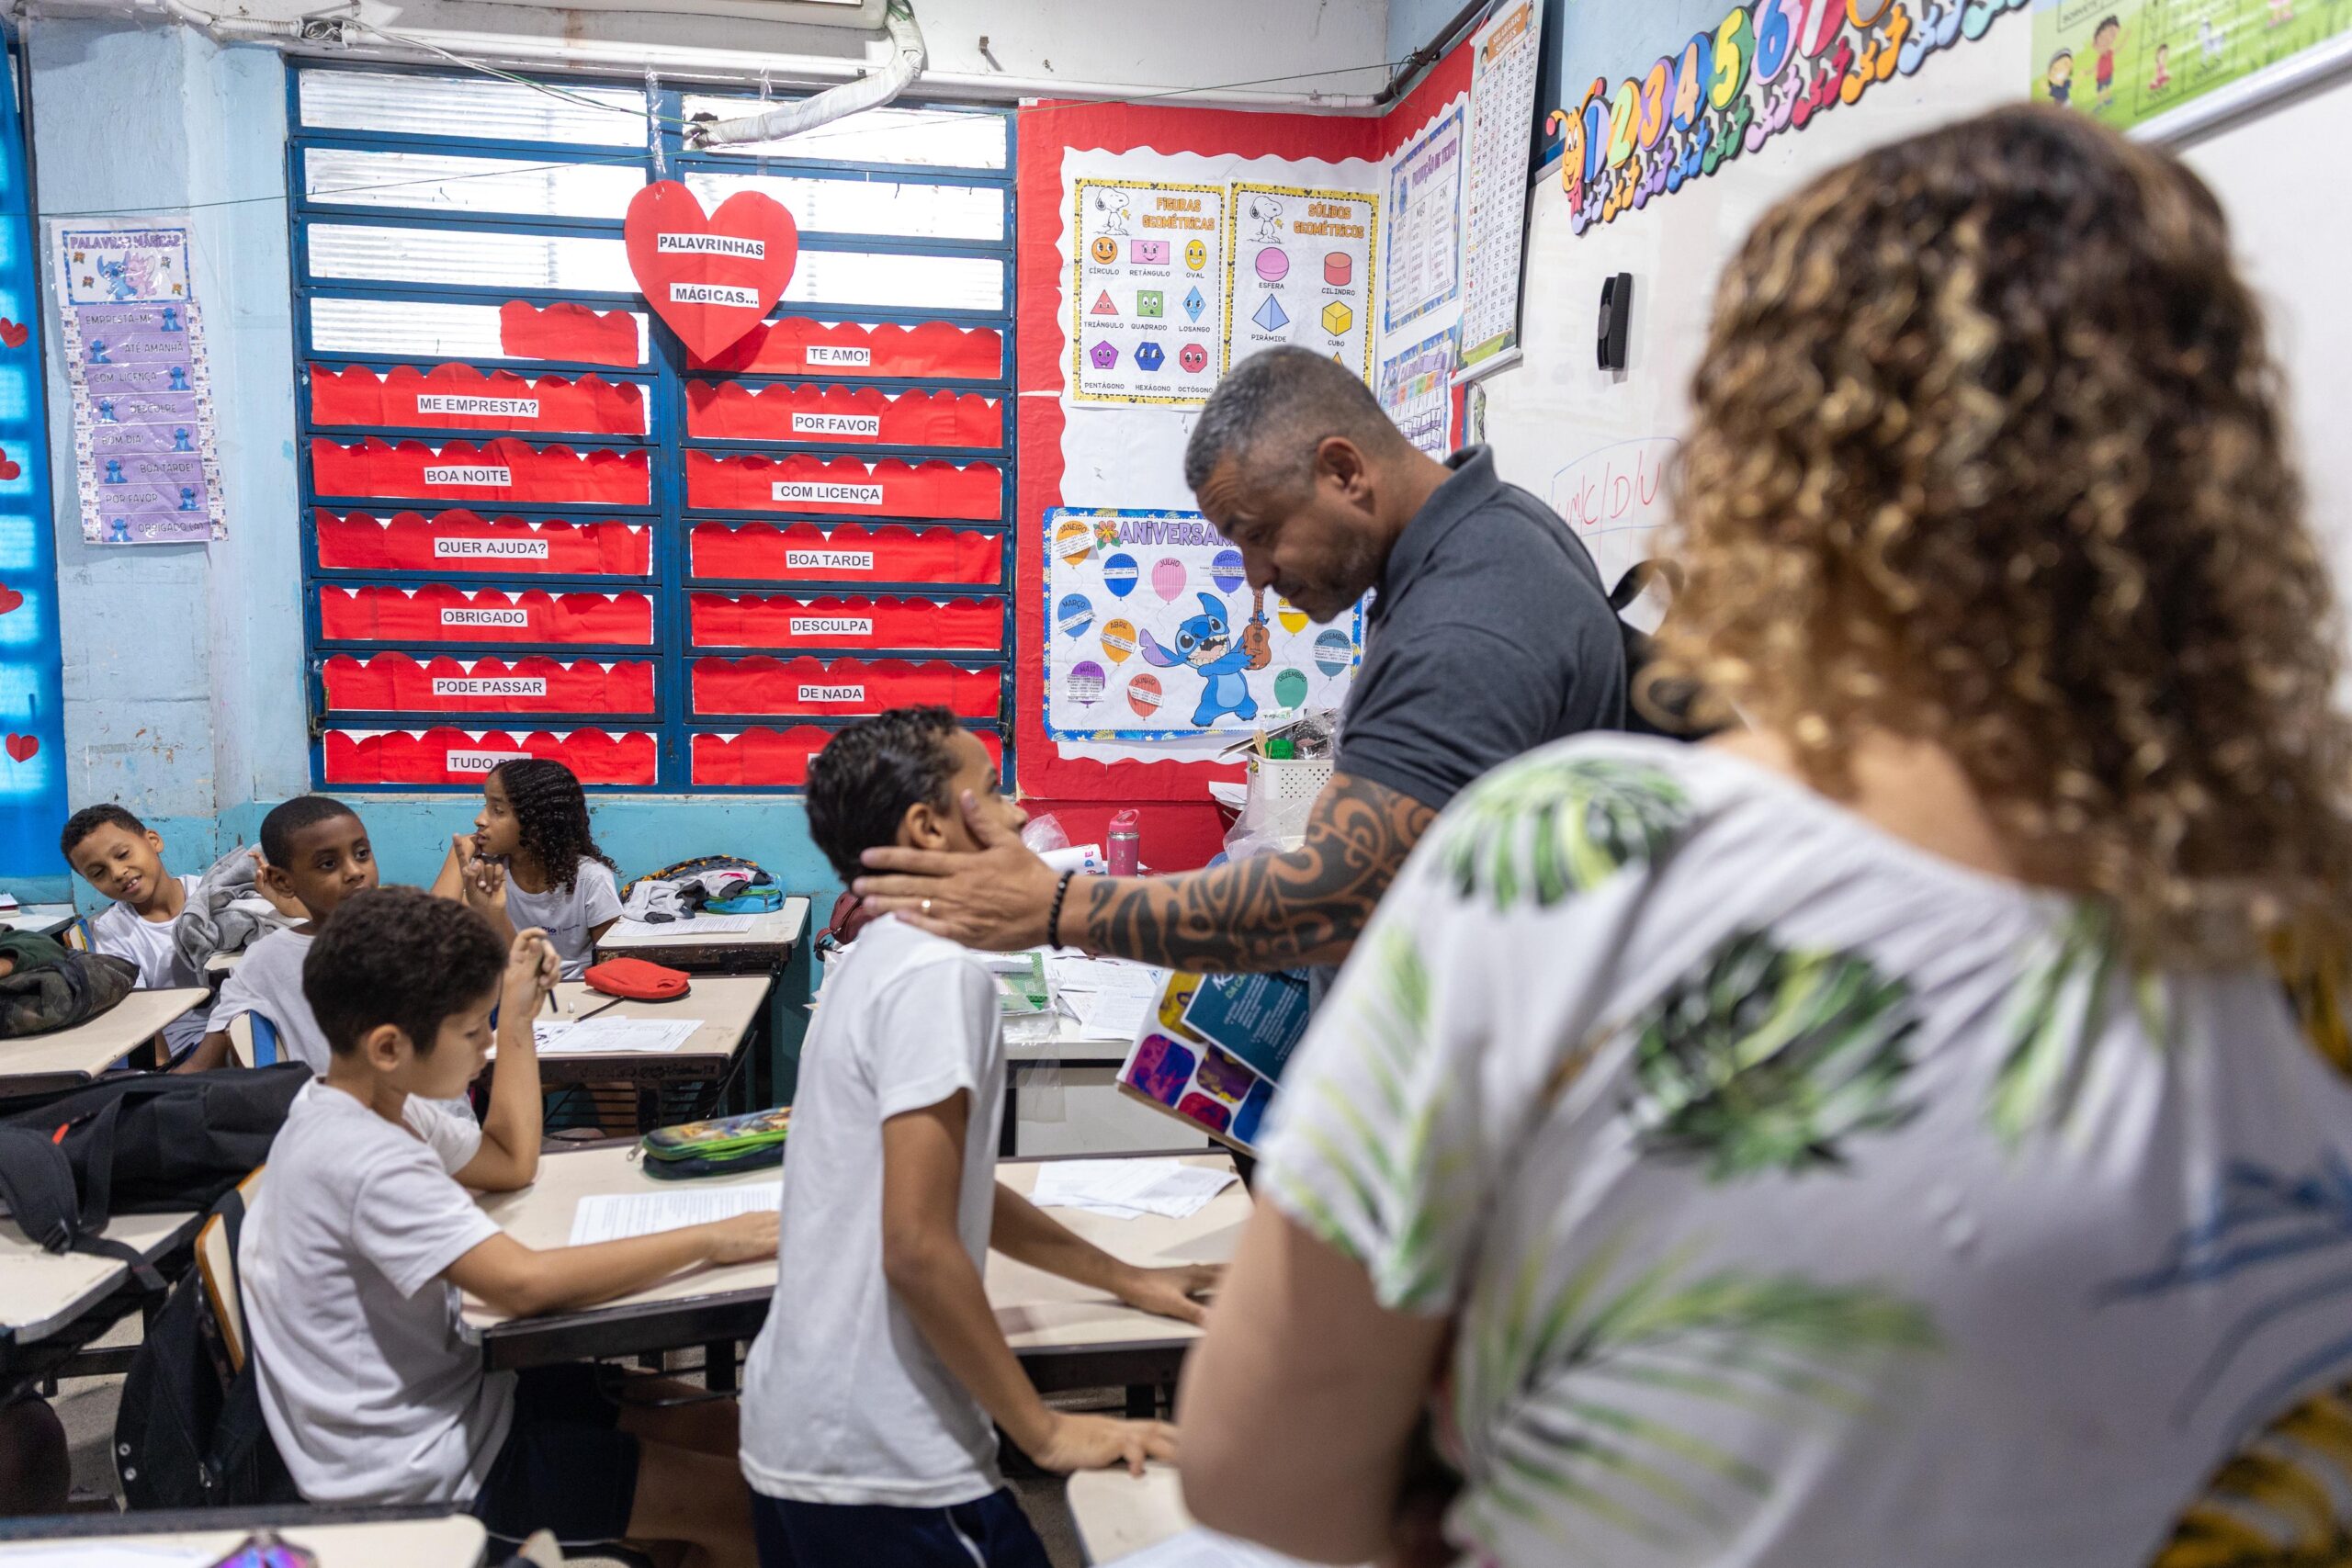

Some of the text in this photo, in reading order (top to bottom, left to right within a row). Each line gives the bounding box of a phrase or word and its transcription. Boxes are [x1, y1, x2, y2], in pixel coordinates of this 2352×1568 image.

[660, 236, 763, 255] PALAVRINHAS
[1090, 267, 1119, 276] CÍRCULO
[675, 288, 758, 305] MÁGICAS...
[125, 341, 184, 353] ATÉ AMANHÃ
[810, 348, 868, 362] TE AMO!
[94, 371, 157, 384] COM LICENÇA
[420, 398, 537, 413] ME EMPRESTA?
[796, 417, 876, 432] POR FAVOR
[140, 463, 194, 473] BOA TARDE!
[427, 470, 509, 481] BOA NOITE
[106, 493, 158, 503] POR FAVOR
[781, 486, 879, 502] COM LICENÇA
[1060, 524, 1087, 534] JANEIRO
[438, 542, 546, 554] QUER AJUDA?
[789, 554, 870, 566] BOA TARDE
[1159, 558, 1181, 568] JULHO
[1217, 554, 1241, 563] AGOSTO
[1062, 599, 1086, 609] MARÇO
[444, 611, 525, 624] OBRIGADO
[792, 620, 868, 631] DESCULPA
[1317, 633, 1350, 645] NOVEMBRO
[1277, 671, 1307, 682] DEZEMBRO
[437, 682, 542, 693] PODE PASSAR
[800, 688, 862, 699] DE NADA
[451, 758, 492, 769] TUDO
